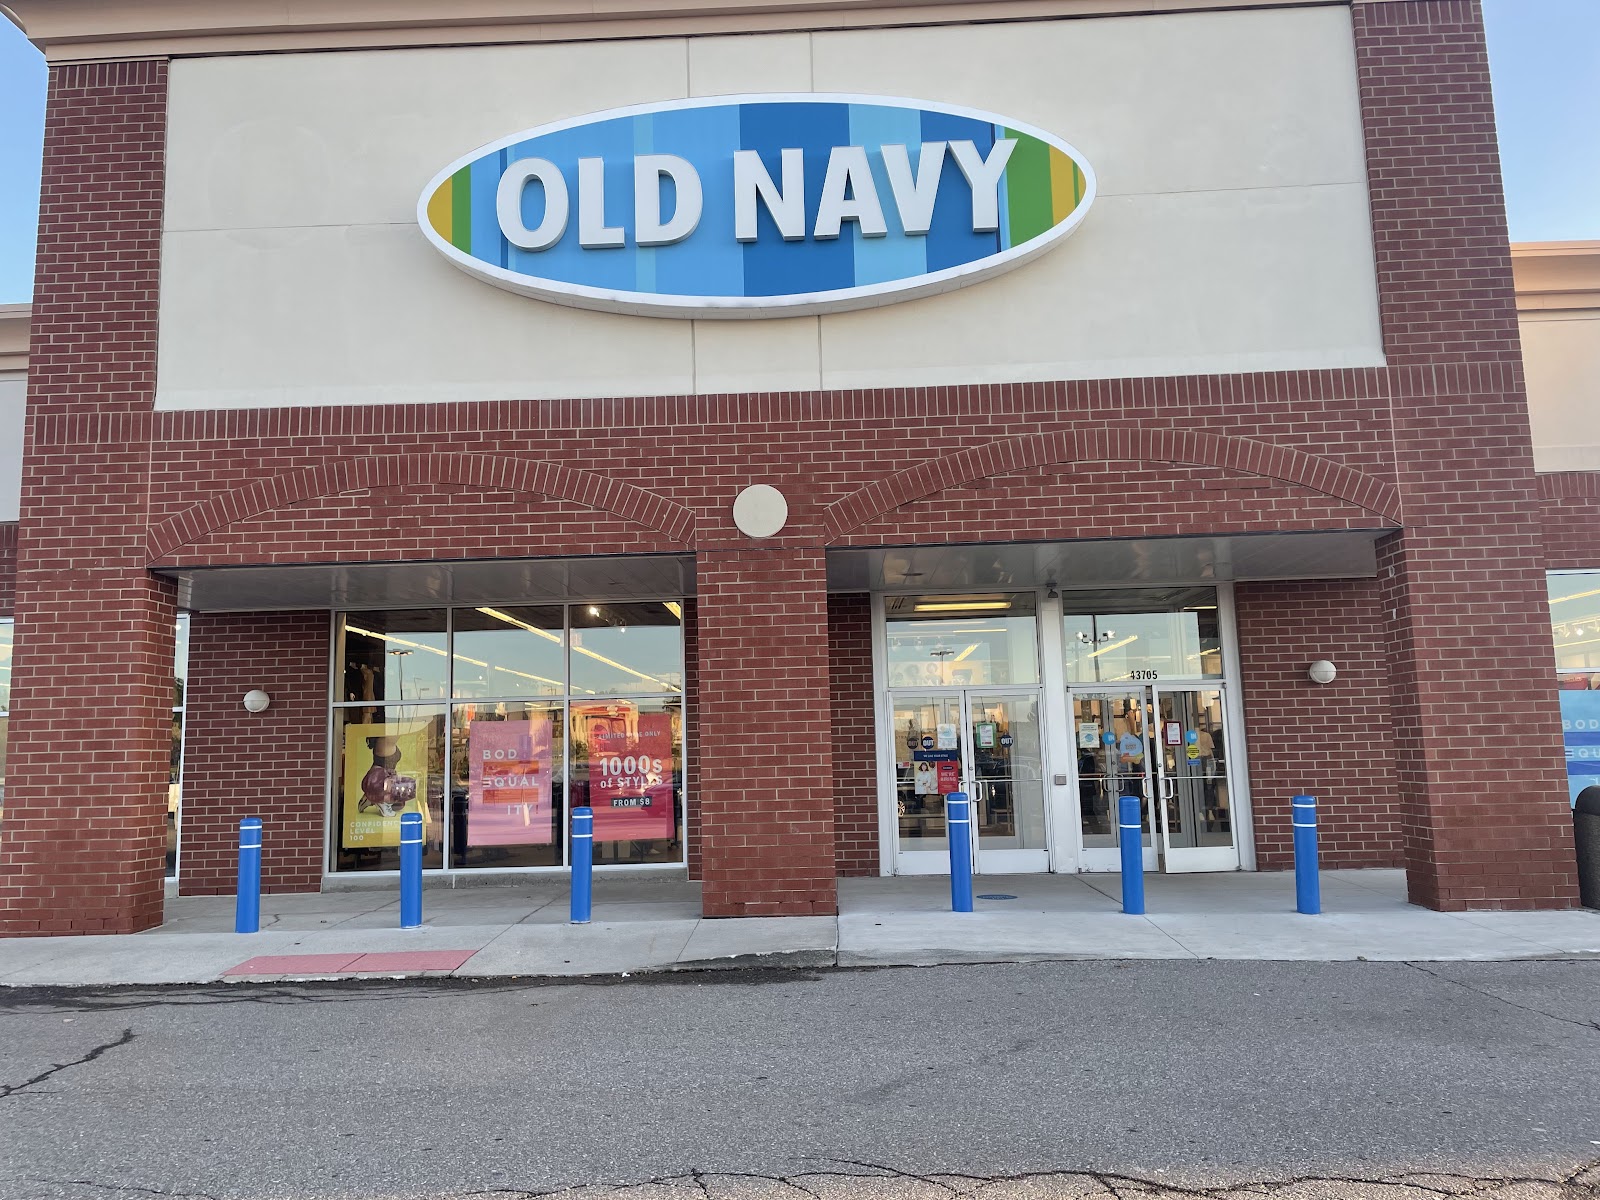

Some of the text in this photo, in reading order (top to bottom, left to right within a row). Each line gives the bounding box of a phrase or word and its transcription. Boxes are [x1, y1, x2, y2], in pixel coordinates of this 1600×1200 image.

[496, 138, 1019, 252] OLD NAVY
[1130, 670, 1158, 680] 43705
[644, 730, 661, 738] ONLY
[922, 739, 934, 747] OUT
[1001, 737, 1013, 745] OUT
[482, 749, 518, 760] BOD
[600, 755, 663, 777] 1000s
[482, 776, 540, 788] EQUAL
[600, 775, 663, 789] of STYLS
[613, 797, 650, 807] FROM $8
